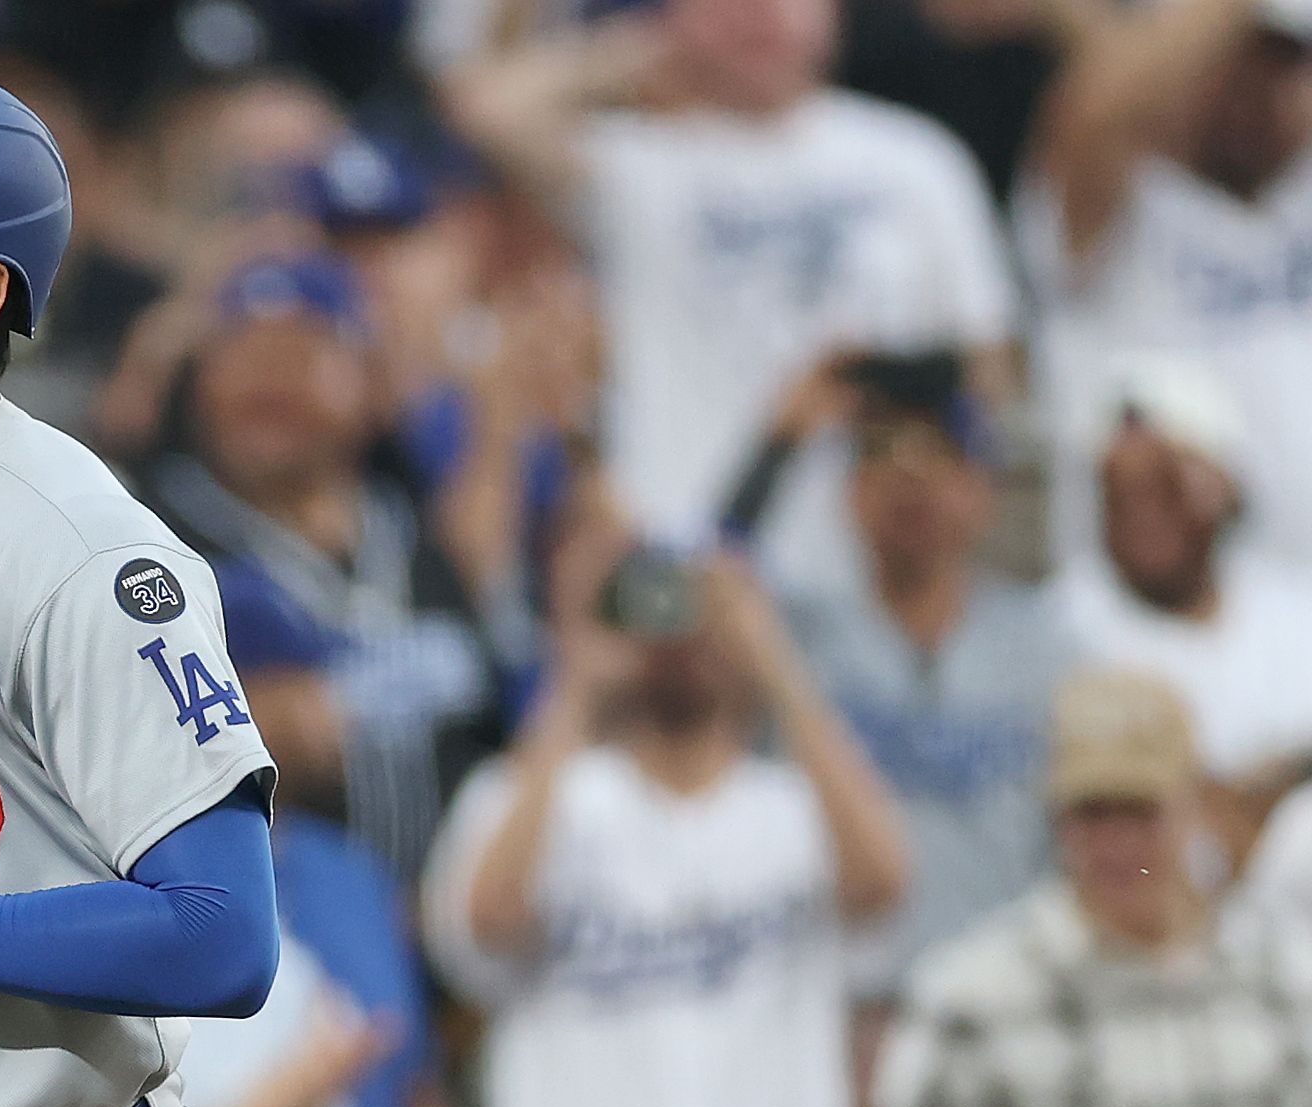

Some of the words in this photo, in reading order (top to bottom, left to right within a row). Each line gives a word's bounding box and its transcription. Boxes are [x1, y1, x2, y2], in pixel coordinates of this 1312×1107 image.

[121, 567, 164, 590] FERNANDO
[132, 577, 179, 615] 34
[137, 636, 251, 747] LA
